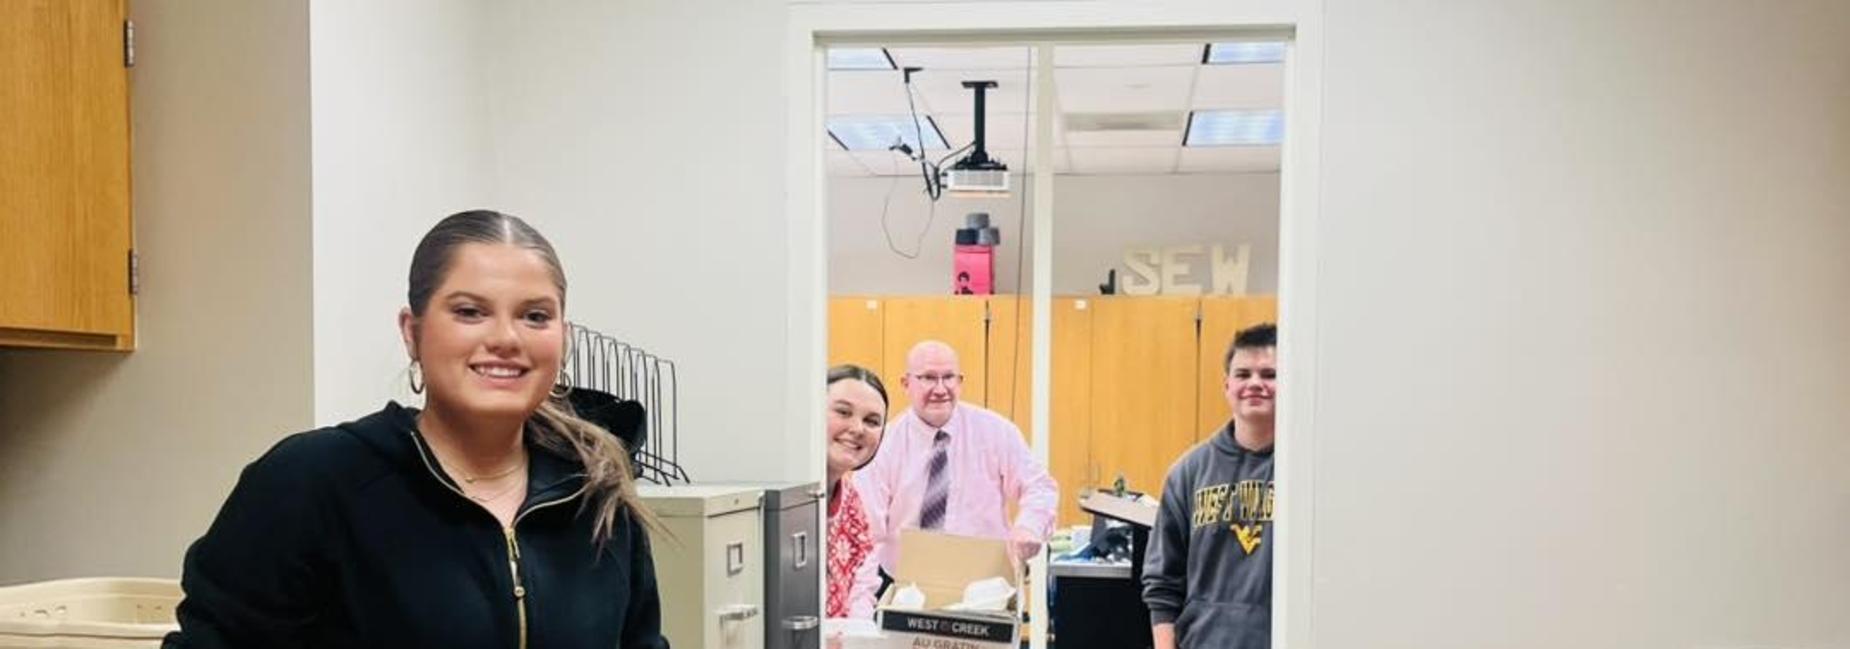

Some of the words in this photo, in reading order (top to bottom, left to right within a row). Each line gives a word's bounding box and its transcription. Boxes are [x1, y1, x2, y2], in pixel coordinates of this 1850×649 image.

[1122, 244, 1250, 295] SEW
[907, 617, 939, 631] WEST
[951, 621, 990, 637] CREEK
